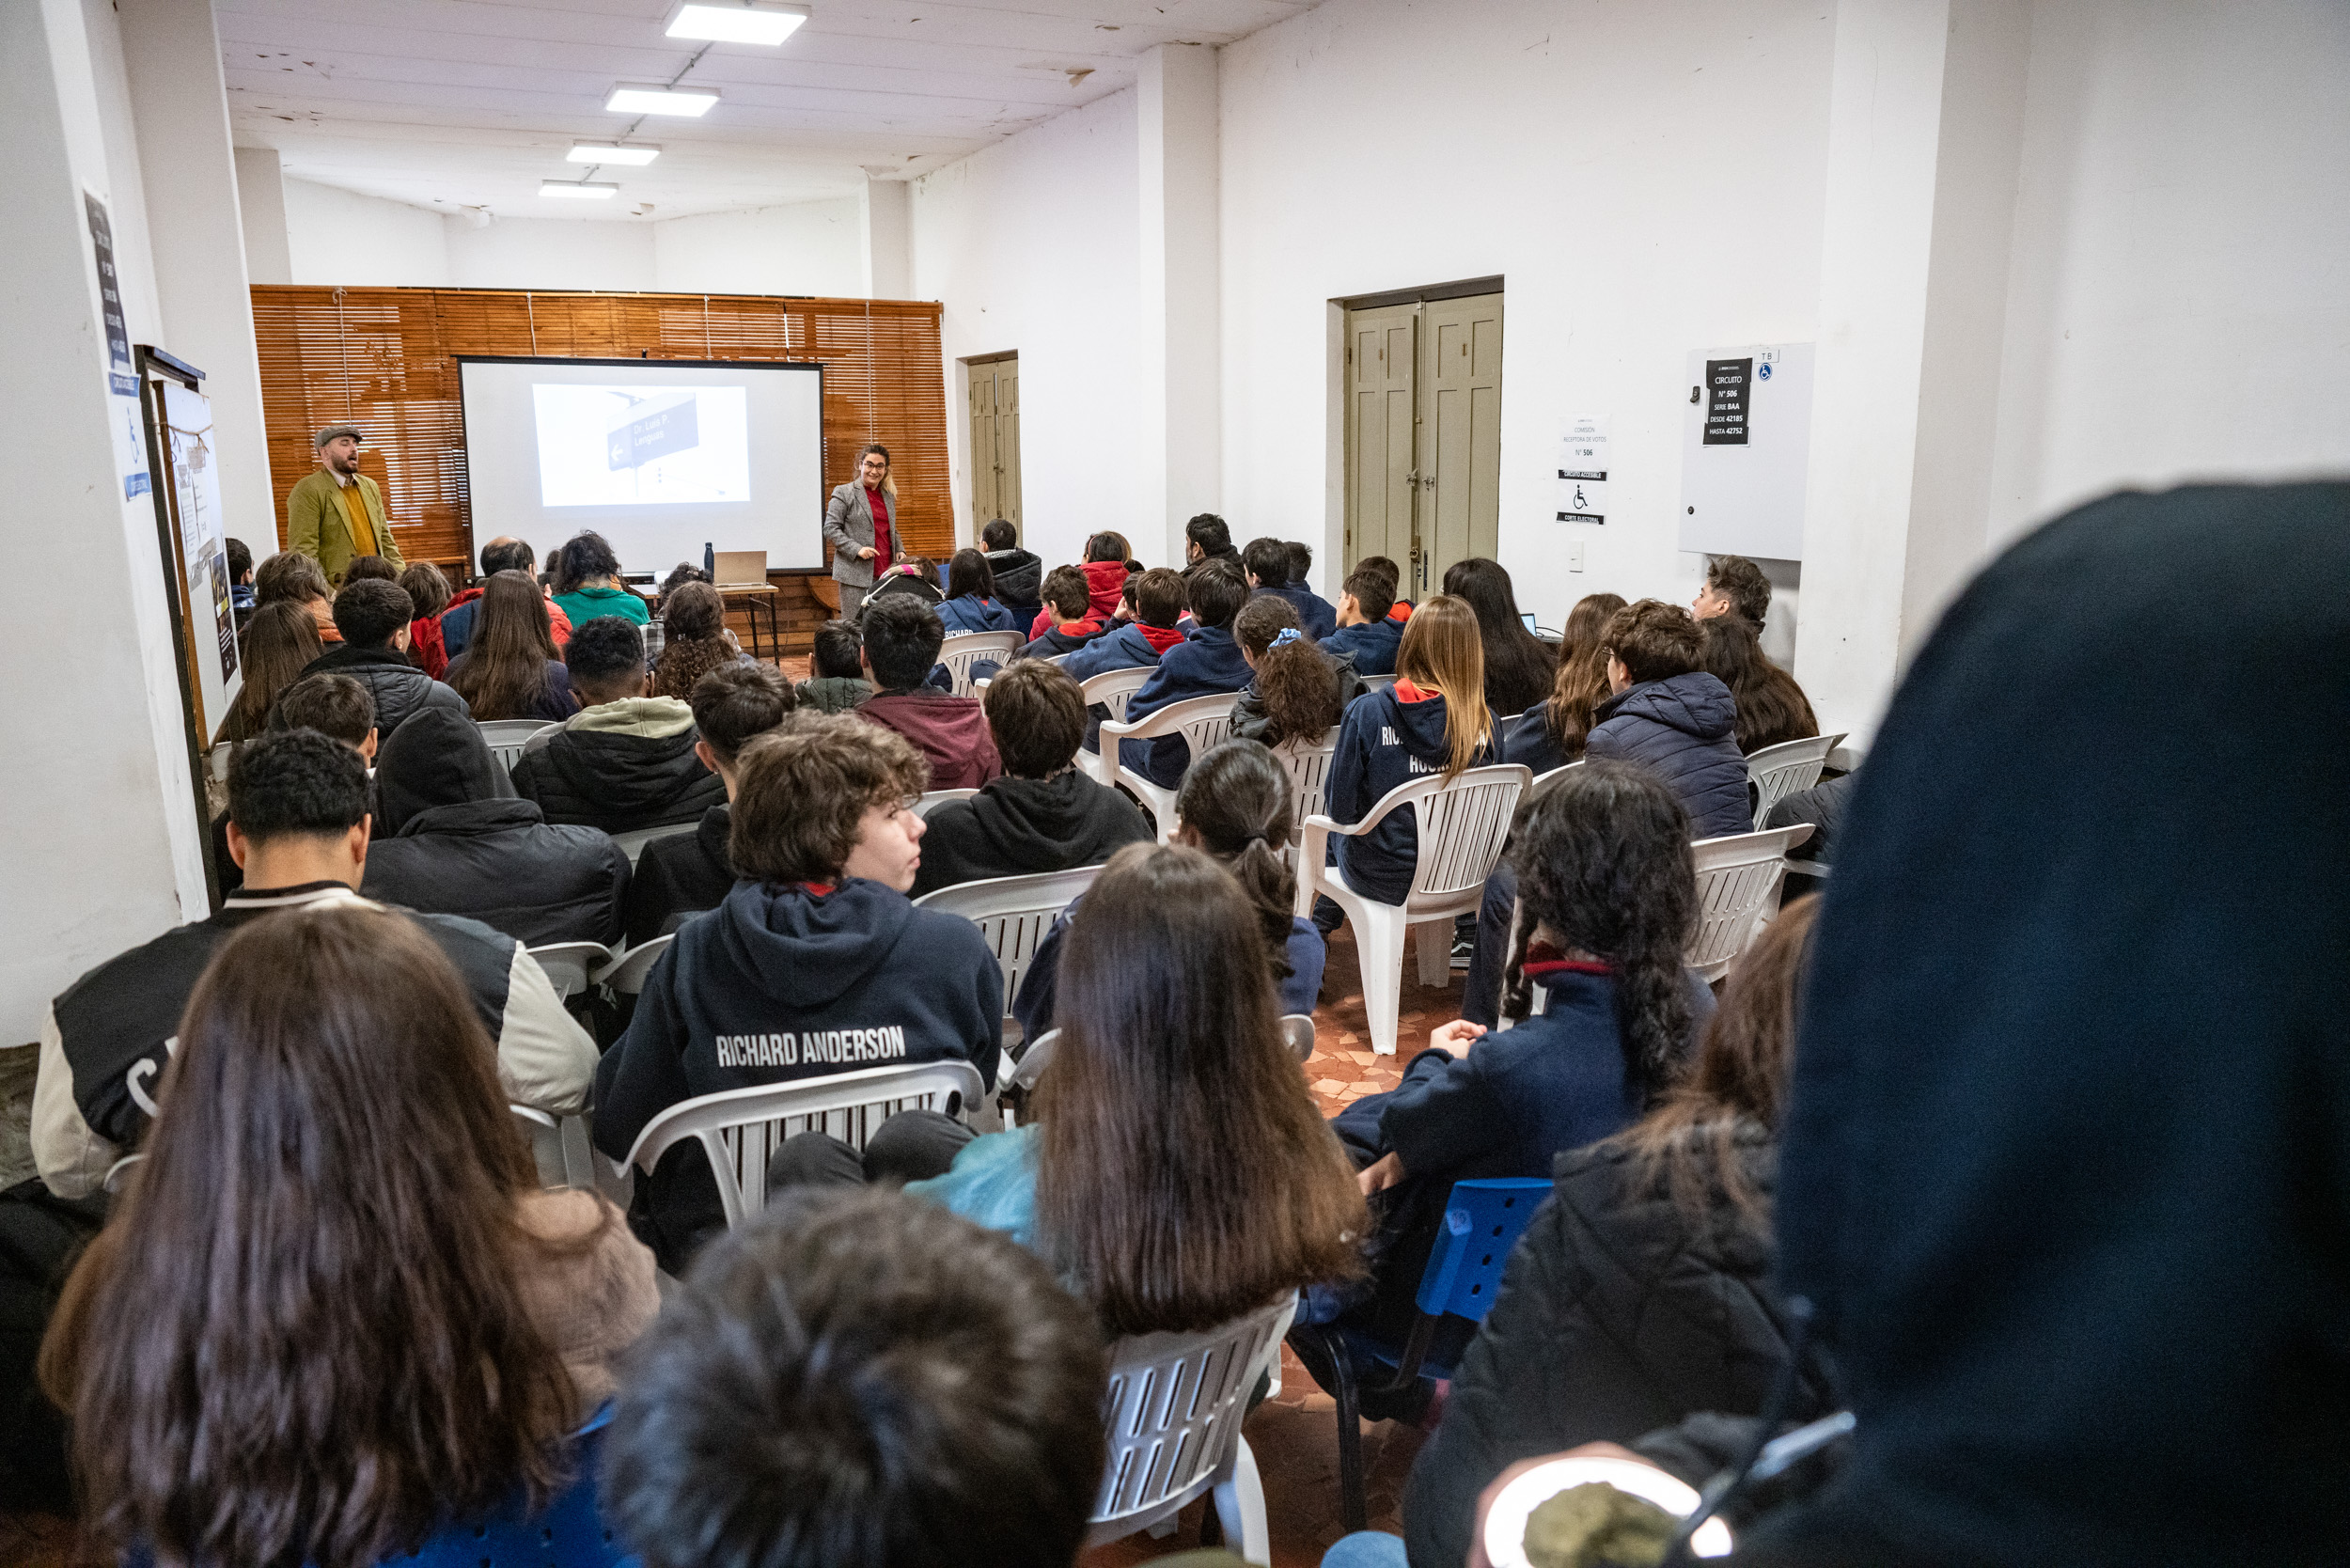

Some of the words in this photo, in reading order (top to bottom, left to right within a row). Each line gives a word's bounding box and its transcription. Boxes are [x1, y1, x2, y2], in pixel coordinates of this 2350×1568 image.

[1715, 375, 1743, 384] CIRCUITO
[1726, 389, 1737, 398] 506
[634, 424, 645, 434] Dr.
[645, 417, 660, 430] Luis
[662, 414, 670, 425] P.
[634, 430, 665, 447] Lenguas
[715, 1032, 798, 1067] RICHARD
[802, 1026, 906, 1064] ANDERSON
